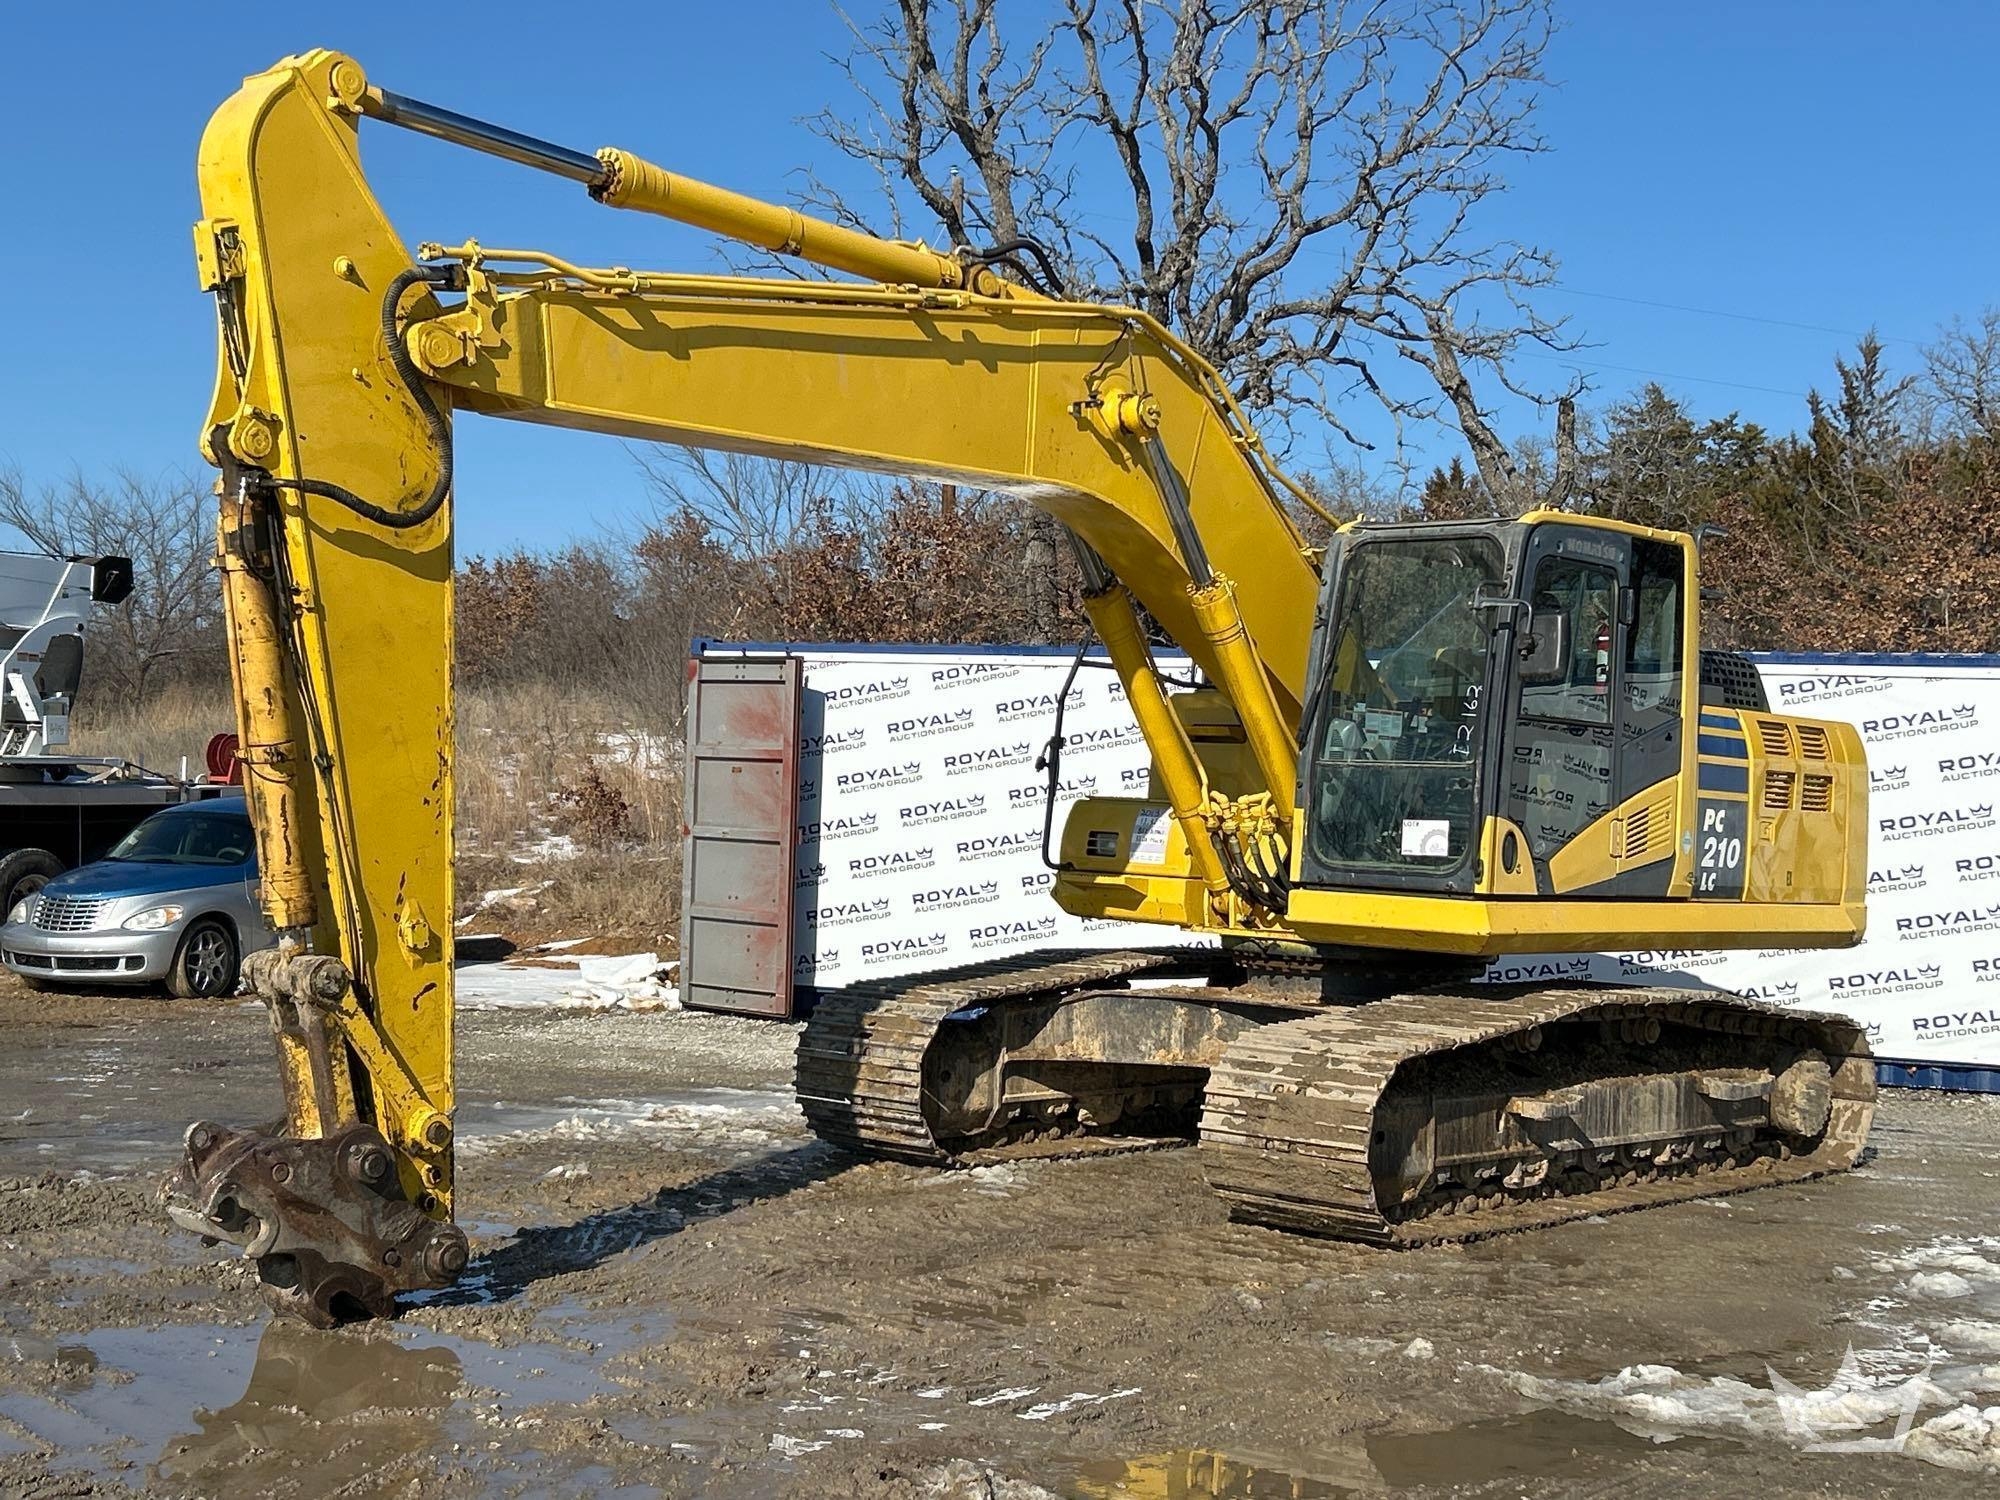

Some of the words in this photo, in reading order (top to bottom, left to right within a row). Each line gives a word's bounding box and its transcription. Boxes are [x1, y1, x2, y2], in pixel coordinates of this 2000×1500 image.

[932, 664, 1000, 682] ROYAL
[934, 677, 981, 690] AUCTION
[982, 669, 1020, 681] GROUP
[825, 681, 891, 702] ROYAL
[1779, 676, 1867, 696] ROYAL
[1782, 690, 1842, 706] AUCTION
[1845, 682, 1893, 696] GROUP
[827, 697, 873, 710] AUCTION
[874, 690, 911, 702] GROUP
[998, 710, 1046, 723] AUCTION
[1047, 702, 1086, 714] GOUP
[1862, 709, 1953, 733] ROYAL
[887, 713, 954, 734] ROYAL
[889, 729, 936, 743] AUCTION
[937, 722, 974, 734] GROUP
[1866, 728, 1927, 743] AUCTION
[1929, 719, 1979, 734] GROUP
[800, 733, 848, 750] OYAL
[830, 742, 867, 754] GROUP
[944, 746, 1012, 767] ROYAL
[946, 763, 993, 776] AUCTION
[995, 756, 1032, 768] GROUP
[1938, 752, 2000, 772] ROY
[837, 766, 903, 786] ROYAL
[840, 782, 885, 794] AUCTION
[886, 775, 923, 787] GROUP
[1869, 781, 1910, 793] ROUP
[900, 799, 967, 819] ROYAL
[902, 815, 948, 828] AUCTION
[949, 808, 987, 820] GROUP
[1702, 808, 1726, 833] PC
[1879, 809, 1970, 832] ROYAL
[1882, 827, 1944, 842] AUCTION
[1946, 819, 1996, 833] GROUP
[843, 826, 879, 838] GROUP
[957, 834, 1025, 853] ROYAL
[1700, 836, 1741, 869] 210
[849, 851, 916, 871] ROYAL
[959, 849, 1006, 862] AUCTION
[851, 866, 898, 879] AUCTION
[898, 860, 936, 872] GROUP
[1959, 871, 2000, 883] AUCTI
[1024, 886, 1051, 896] AUCT
[1699, 872, 1717, 891] LC
[1878, 880, 1927, 893] GROUP
[912, 885, 980, 905] ROYAL
[914, 901, 961, 913] AUCTION
[962, 894, 1000, 906] GROUP
[806, 902, 872, 922] ROYAL
[808, 917, 854, 930] AUCTION
[855, 911, 892, 923] GROUP
[1896, 909, 1987, 931] ROYAL
[970, 921, 1039, 940] ROYAL
[972, 936, 1019, 949] AUCTION
[1020, 930, 1058, 942] GROUP
[1899, 927, 1961, 941] AUCTION
[1964, 922, 2000, 933] GROU
[862, 937, 928, 956] ROYAL
[864, 953, 910, 965] AUCTION
[911, 946, 949, 959] GROUP
[1488, 962, 1569, 982] ROYAL
[1621, 963, 1679, 976] AUCTION
[1681, 956, 1728, 969] GROUP
[1829, 969, 1918, 989] ROYAL
[1831, 985, 1892, 1000] AUCTION
[1894, 980, 1944, 993] GROUP
[1915, 1027, 1978, 1041] AUCTION
